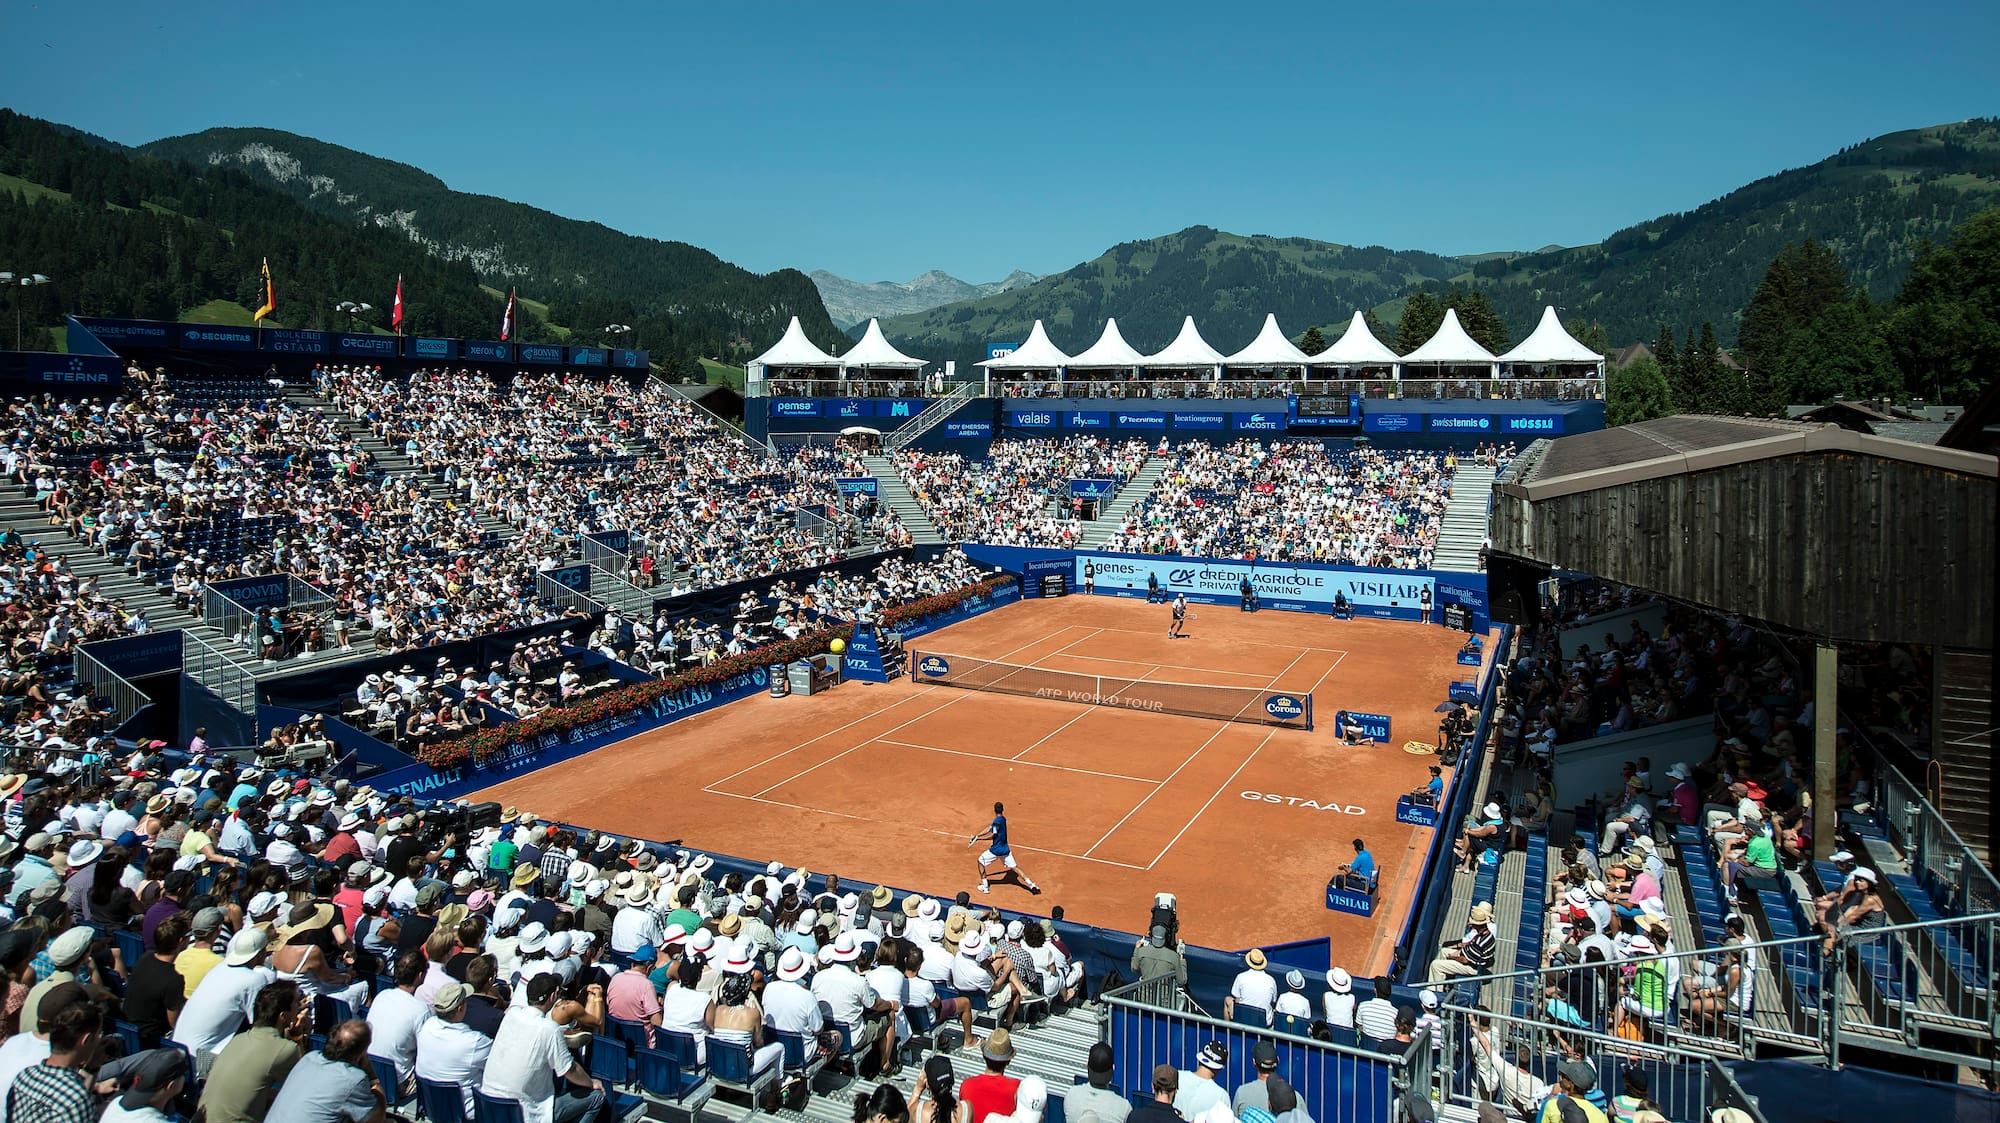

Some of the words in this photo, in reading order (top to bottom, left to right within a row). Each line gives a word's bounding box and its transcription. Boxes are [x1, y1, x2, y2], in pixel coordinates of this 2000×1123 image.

[202, 332, 251, 342] SECURITAS
[274, 330, 321, 340] MOLKEREI
[274, 342, 321, 352] GSTAAD
[342, 338, 393, 349] ORGATENT
[470, 347, 494, 355] xerox
[533, 348, 560, 357] BONVIN
[43, 371, 108, 382] ETERNA
[777, 401, 811, 413] pemsa
[1017, 411, 1050, 424] valais
[1174, 413, 1223, 423] locationgroup
[1431, 417, 1478, 427] swisstennis
[1028, 560, 1073, 571] locationgroup
[1199, 569, 1249, 581] CRÉDIT
[1252, 573, 1324, 587] AGRICOLE
[232, 583, 284, 600] BONVIN
[1349, 580, 1419, 599] VISILAB
[1440, 585, 1474, 598] nationale
[1459, 596, 1483, 607] suisse
[847, 659, 869, 668] VTX
[920, 661, 948, 674] Corona
[1035, 687, 1062, 698] ATP
[1067, 690, 1119, 705] WORLD
[1124, 697, 1164, 711] TOUR
[1266, 703, 1301, 714] Corona
[1241, 790, 1366, 816] GSTAAD
[1398, 813, 1432, 825] LACOSTE
[1328, 893, 1370, 912] VISILAB
